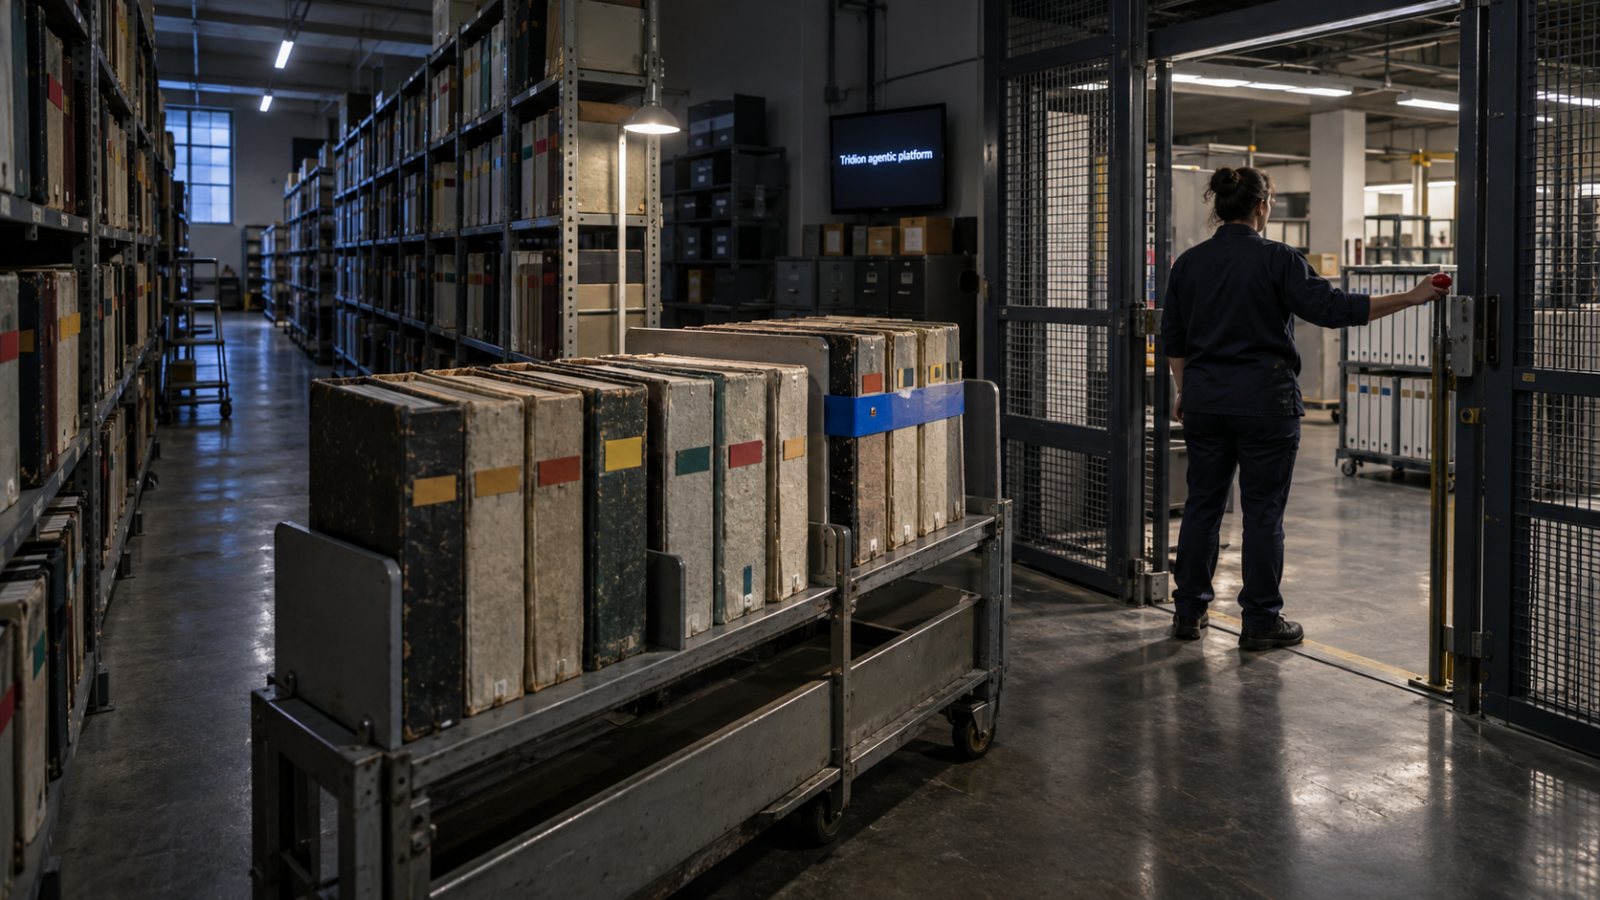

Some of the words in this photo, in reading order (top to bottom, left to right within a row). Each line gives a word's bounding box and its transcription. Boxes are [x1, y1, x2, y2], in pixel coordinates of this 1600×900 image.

[840, 154, 866, 165] Tridion
[868, 152, 897, 165] agentic
[898, 149, 933, 163] platform
